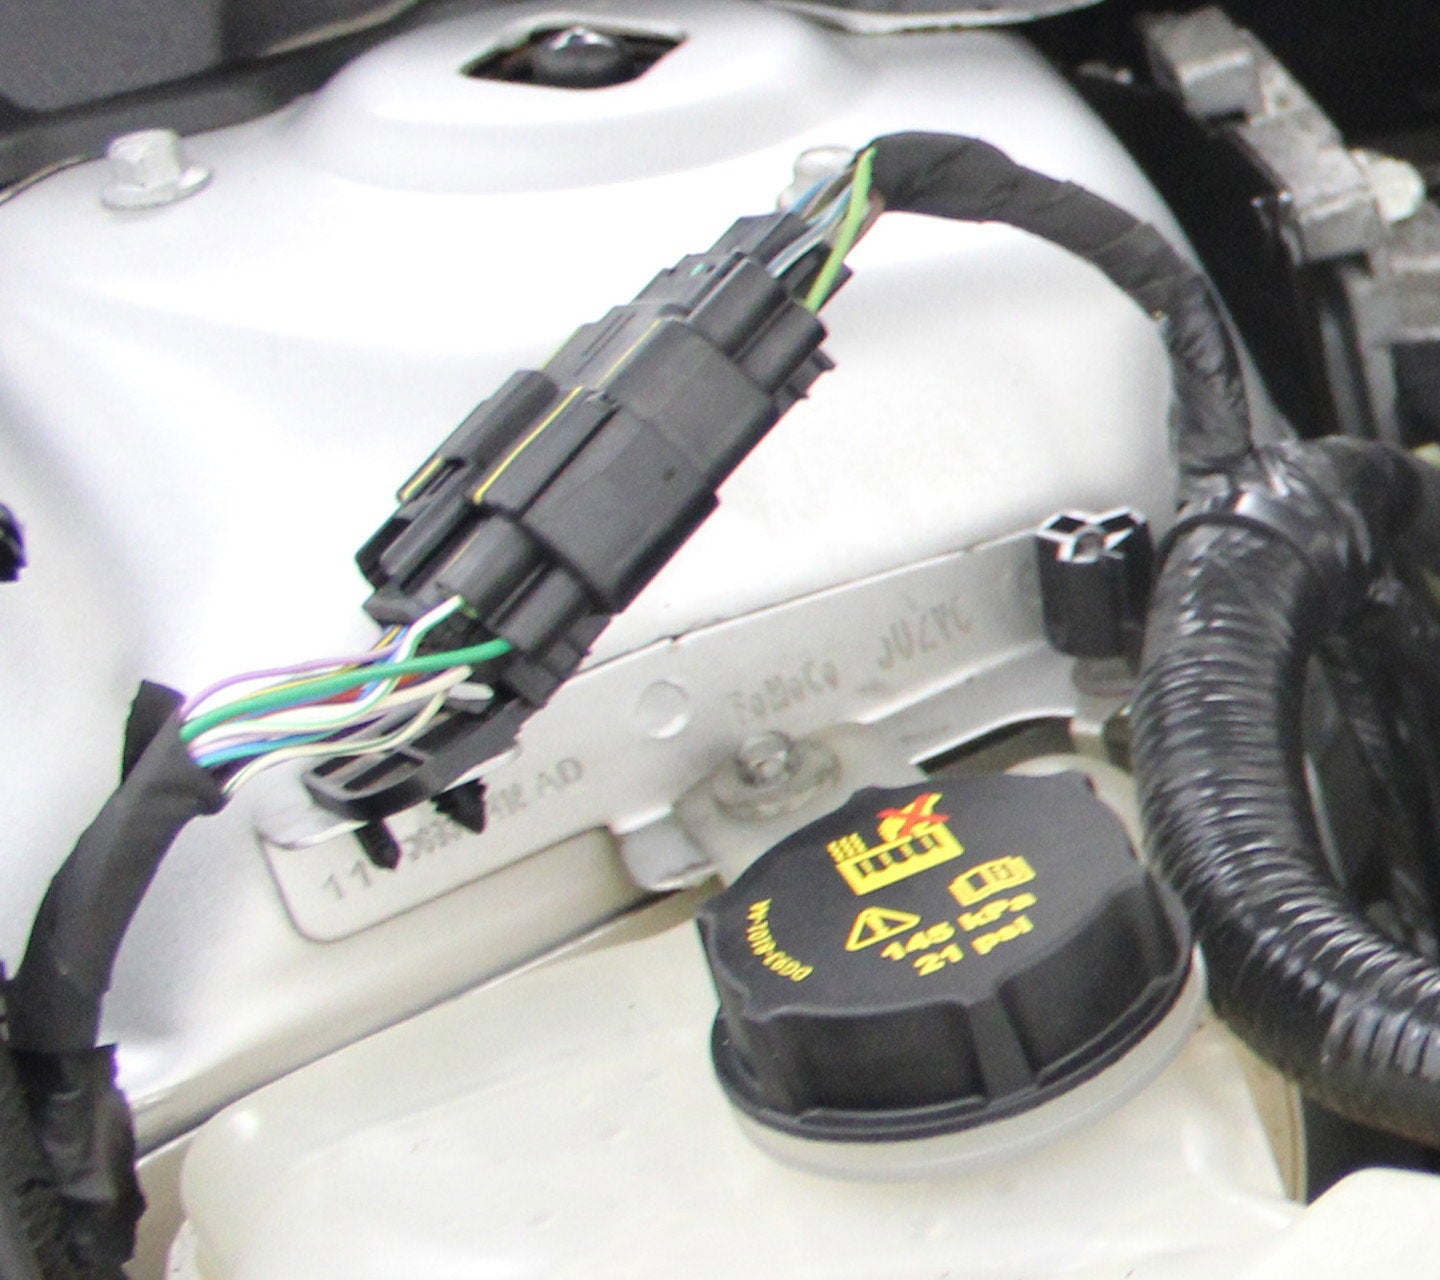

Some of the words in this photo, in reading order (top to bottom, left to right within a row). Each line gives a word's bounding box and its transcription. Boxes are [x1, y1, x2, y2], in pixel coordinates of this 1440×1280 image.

[879, 921, 956, 962] 145
[912, 942, 965, 977] 21
[971, 914, 1035, 956] psi
